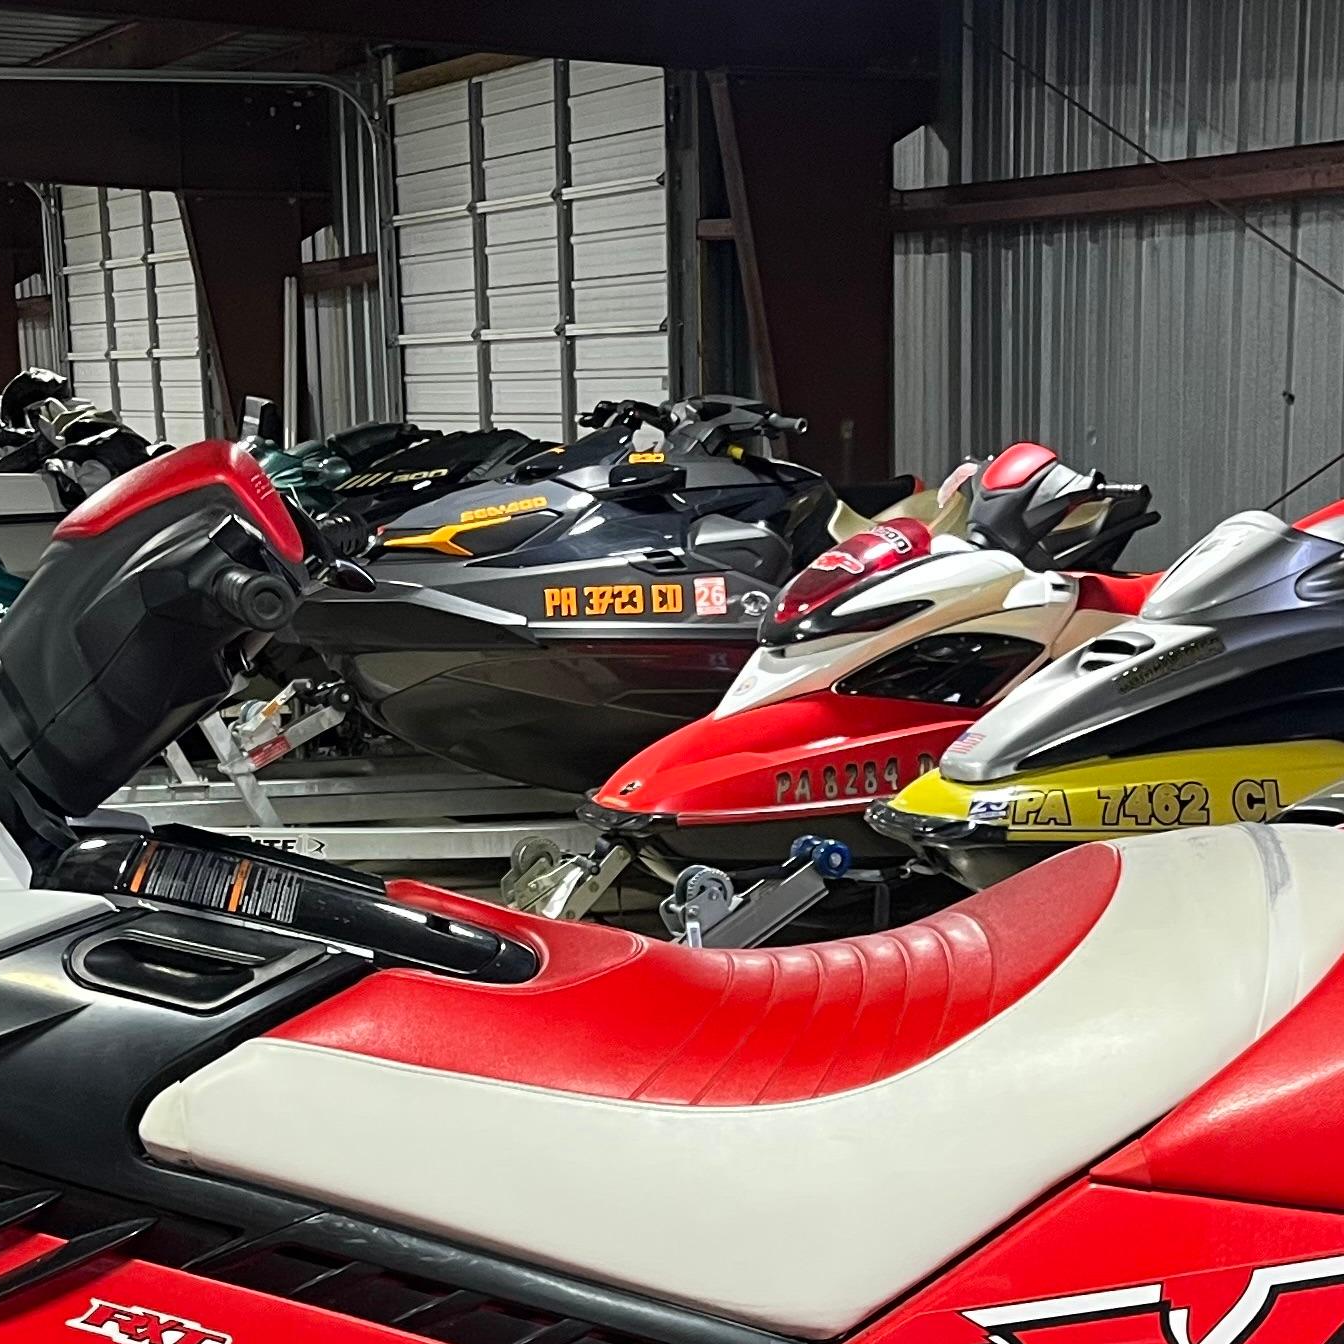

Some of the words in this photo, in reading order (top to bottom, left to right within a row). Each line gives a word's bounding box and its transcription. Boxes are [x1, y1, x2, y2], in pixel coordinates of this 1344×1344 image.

[544, 587, 577, 617] PA
[775, 770, 811, 802] PA
[1012, 790, 1072, 826] PA
[1097, 780, 1211, 826] 7462
